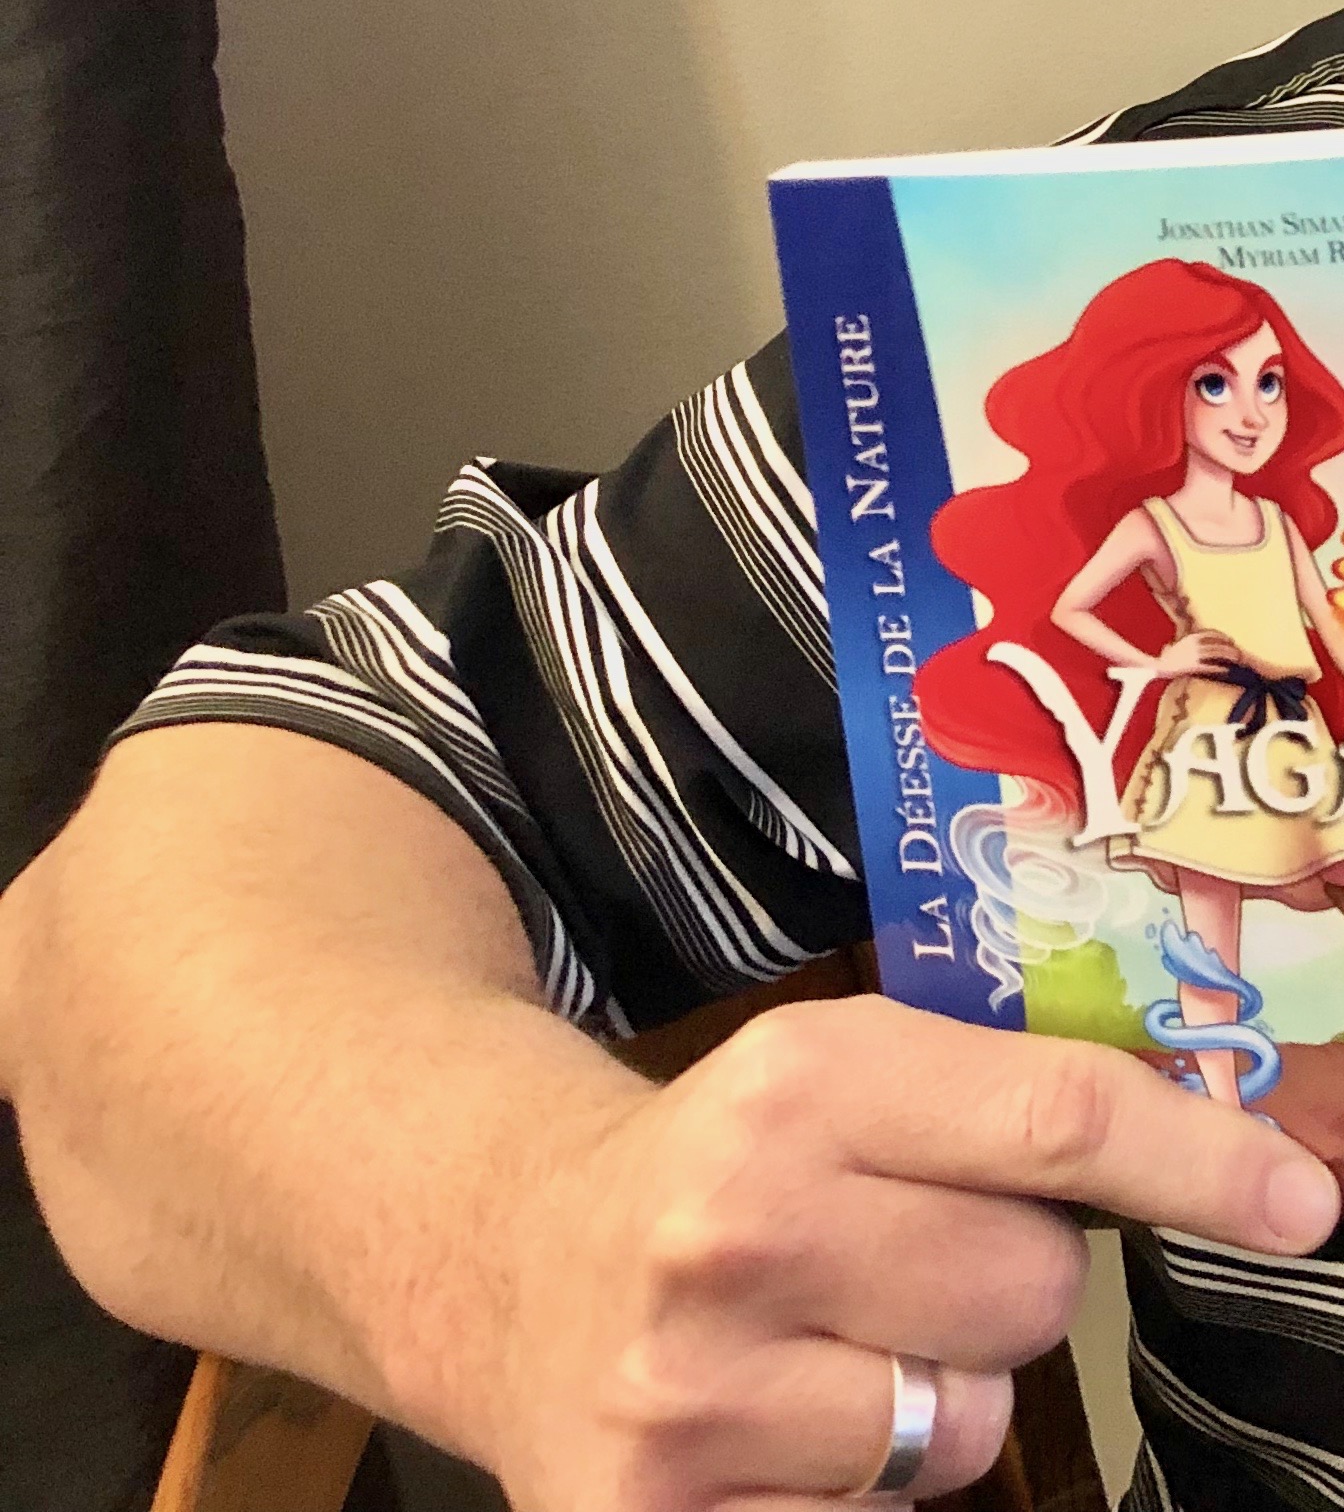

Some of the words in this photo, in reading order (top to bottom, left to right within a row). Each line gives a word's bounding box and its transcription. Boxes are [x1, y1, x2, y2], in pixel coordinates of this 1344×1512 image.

[1156, 217, 1275, 242] JONATHAN
[1217, 245, 1320, 269] MYRIAM
[834, 313, 896, 524] NATURE
[868, 538, 906, 598] LA
[877, 613, 917, 676] DE
[887, 694, 944, 877] DÉESSE
[912, 892, 956, 963] LA
